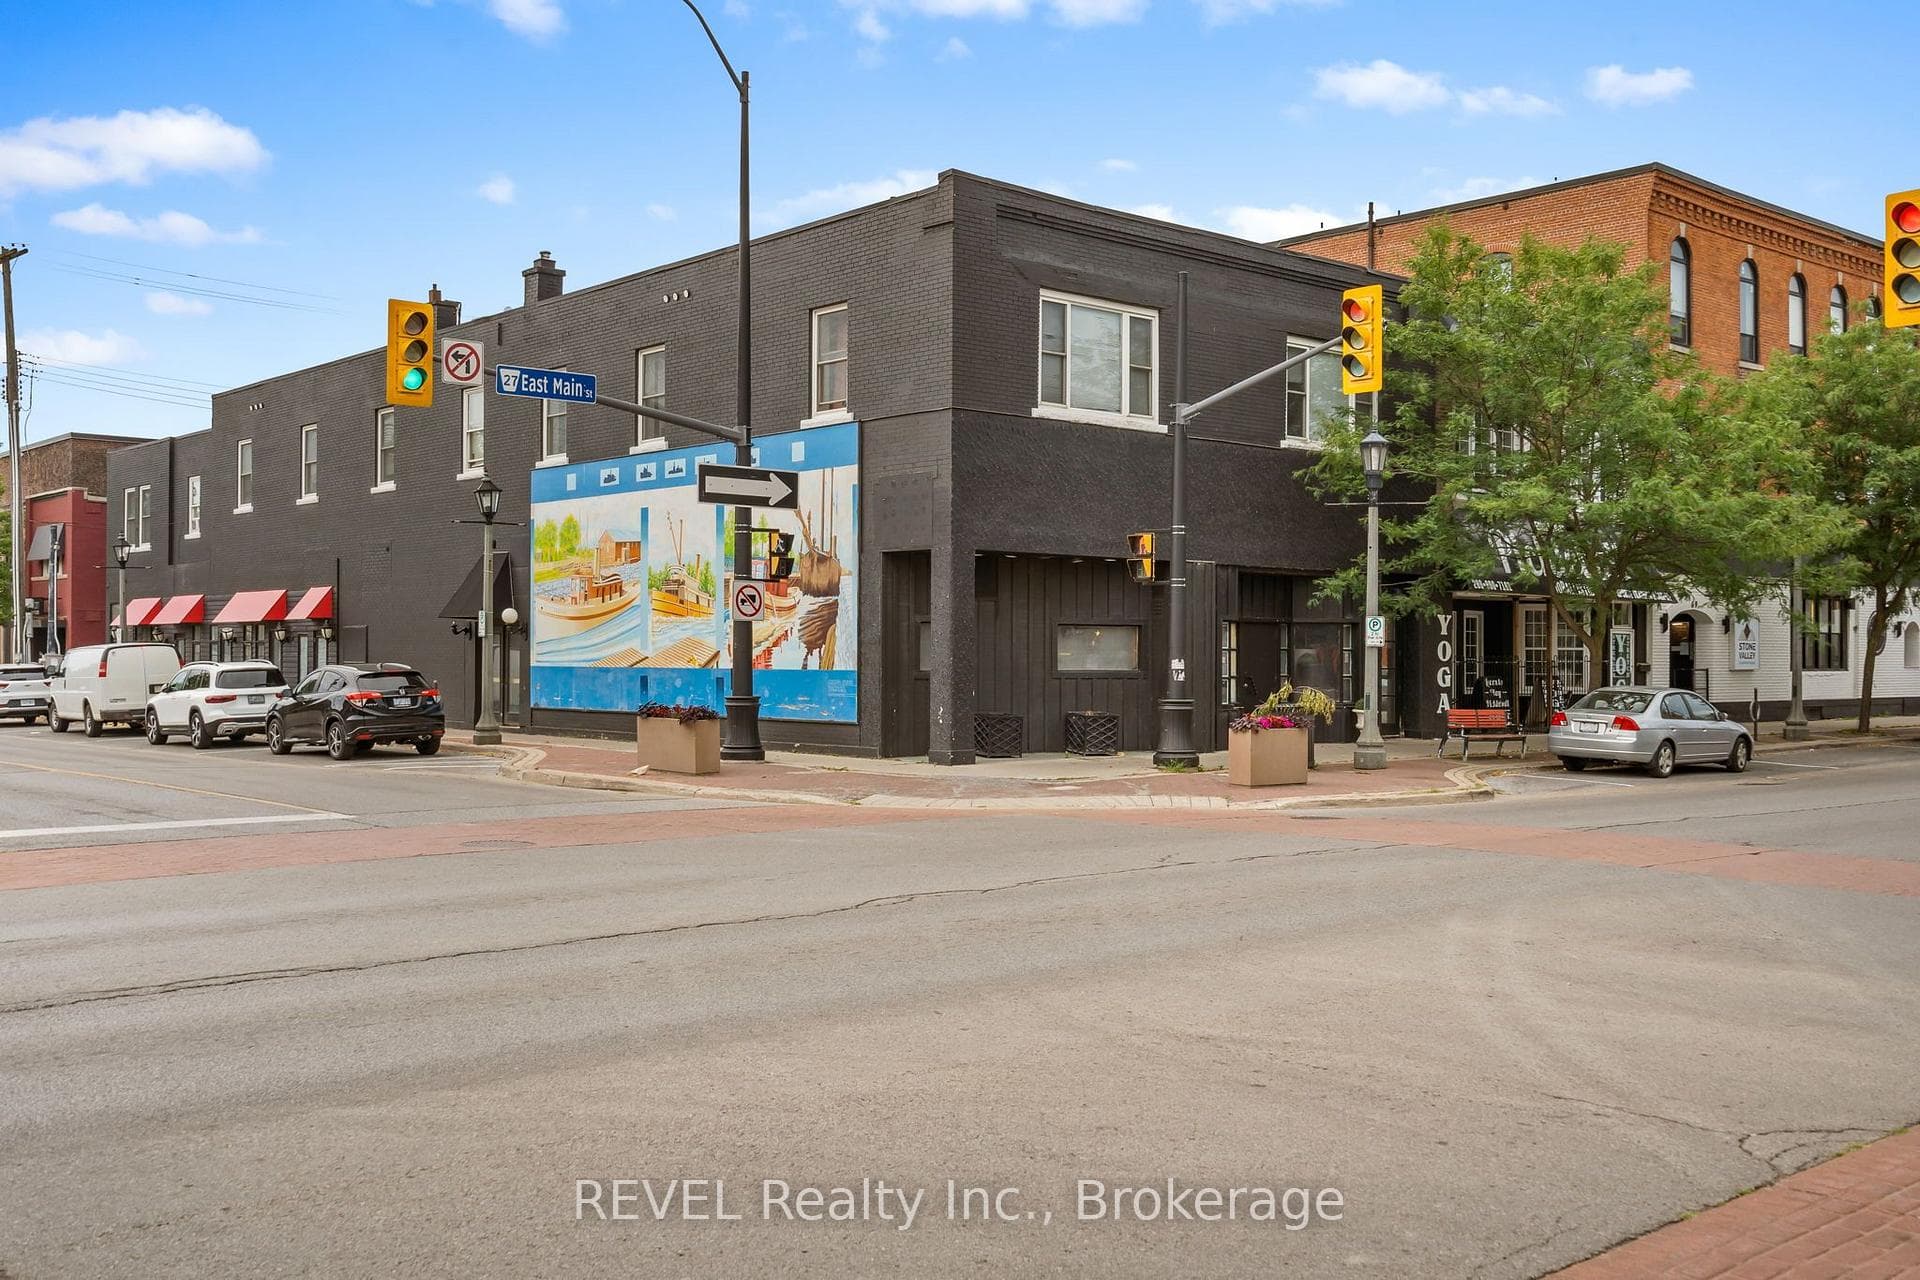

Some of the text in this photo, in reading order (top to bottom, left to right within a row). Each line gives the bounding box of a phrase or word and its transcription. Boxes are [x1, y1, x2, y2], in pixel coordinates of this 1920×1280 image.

[503, 374, 518, 387] 27
[521, 374, 593, 398] East Main St
[1738, 642, 1756, 651] STONE
[1436, 614, 1453, 714] YOGA
